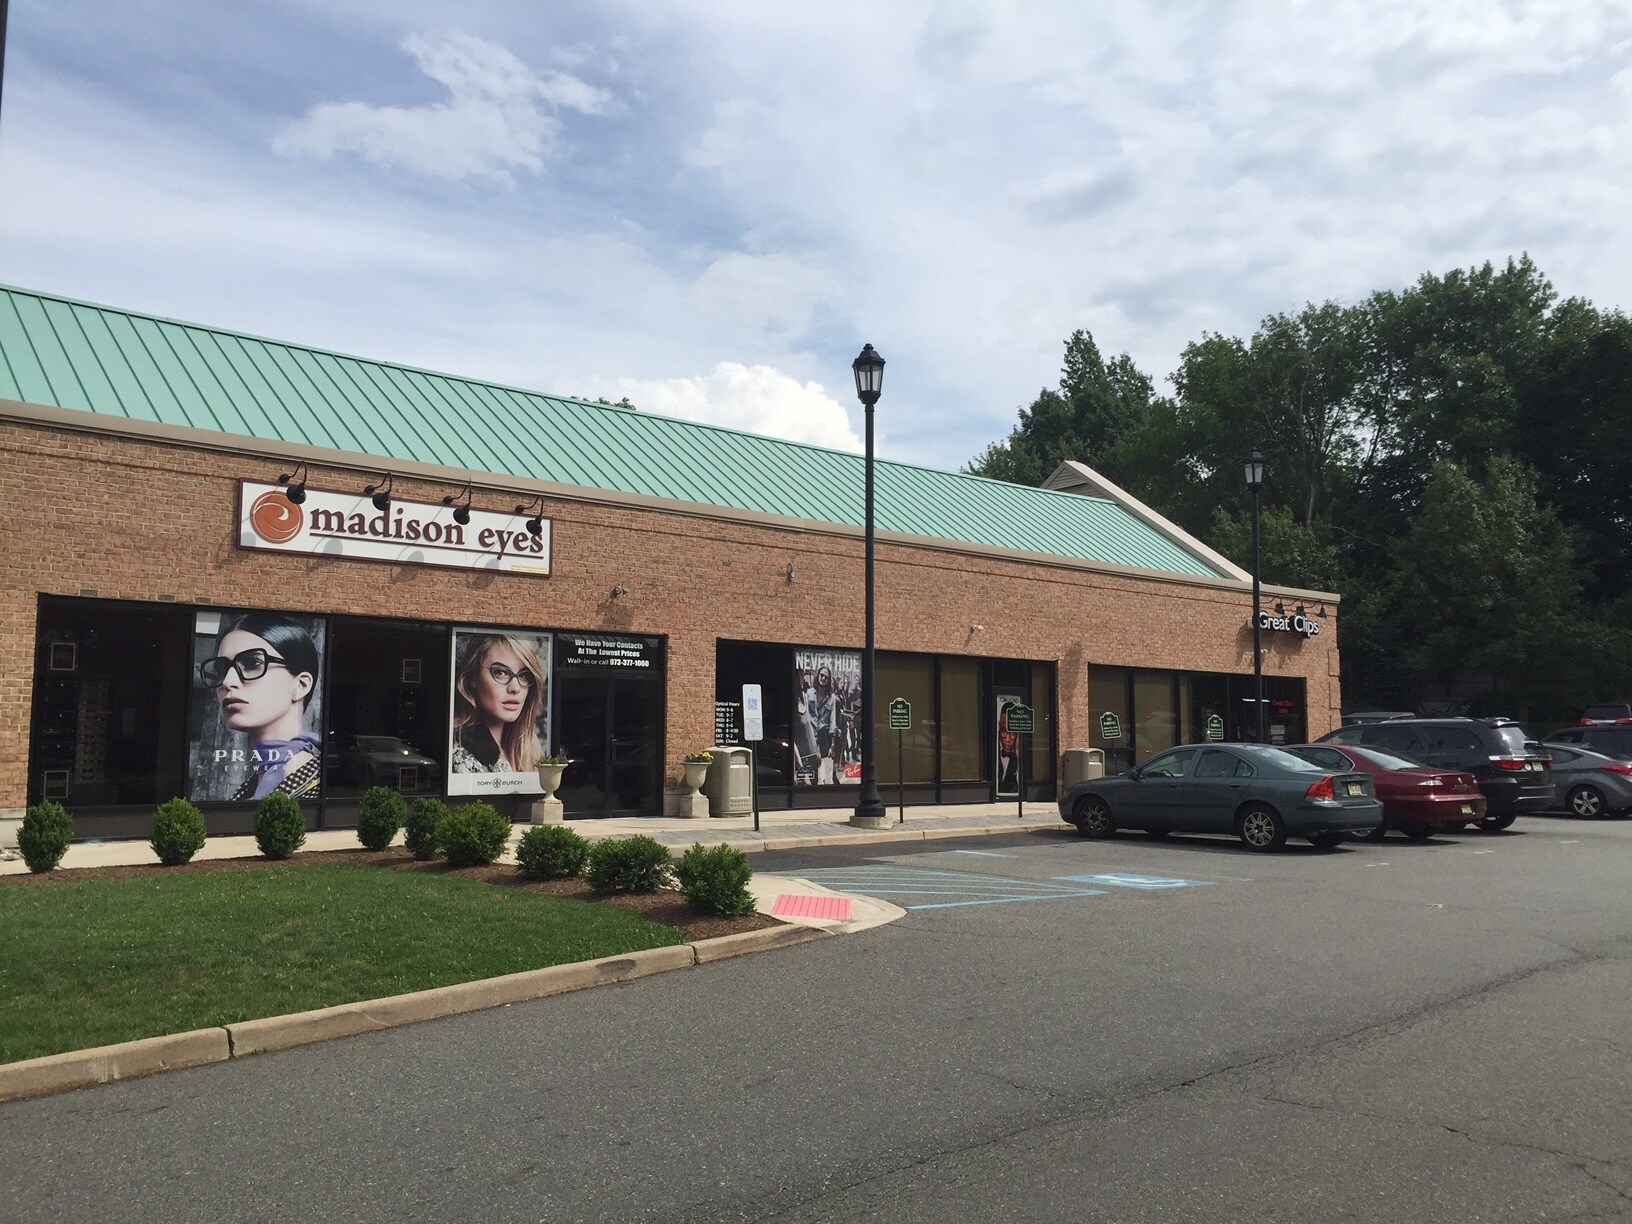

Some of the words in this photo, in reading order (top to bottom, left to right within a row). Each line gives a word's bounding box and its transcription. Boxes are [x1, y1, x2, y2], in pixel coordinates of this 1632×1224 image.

[309, 507, 465, 545] madison
[478, 527, 544, 560] eyes
[1259, 611, 1290, 631] Great
[1294, 614, 1319, 636] Clips
[578, 647, 585, 655] At
[599, 648, 620, 656] Lowest
[621, 649, 640, 657] Prices
[602, 640, 616, 648] Your
[616, 641, 643, 650] Contacts
[796, 651, 832, 671] NEVER
[834, 654, 860, 672] HIDE
[214, 749, 295, 762] PRADA
